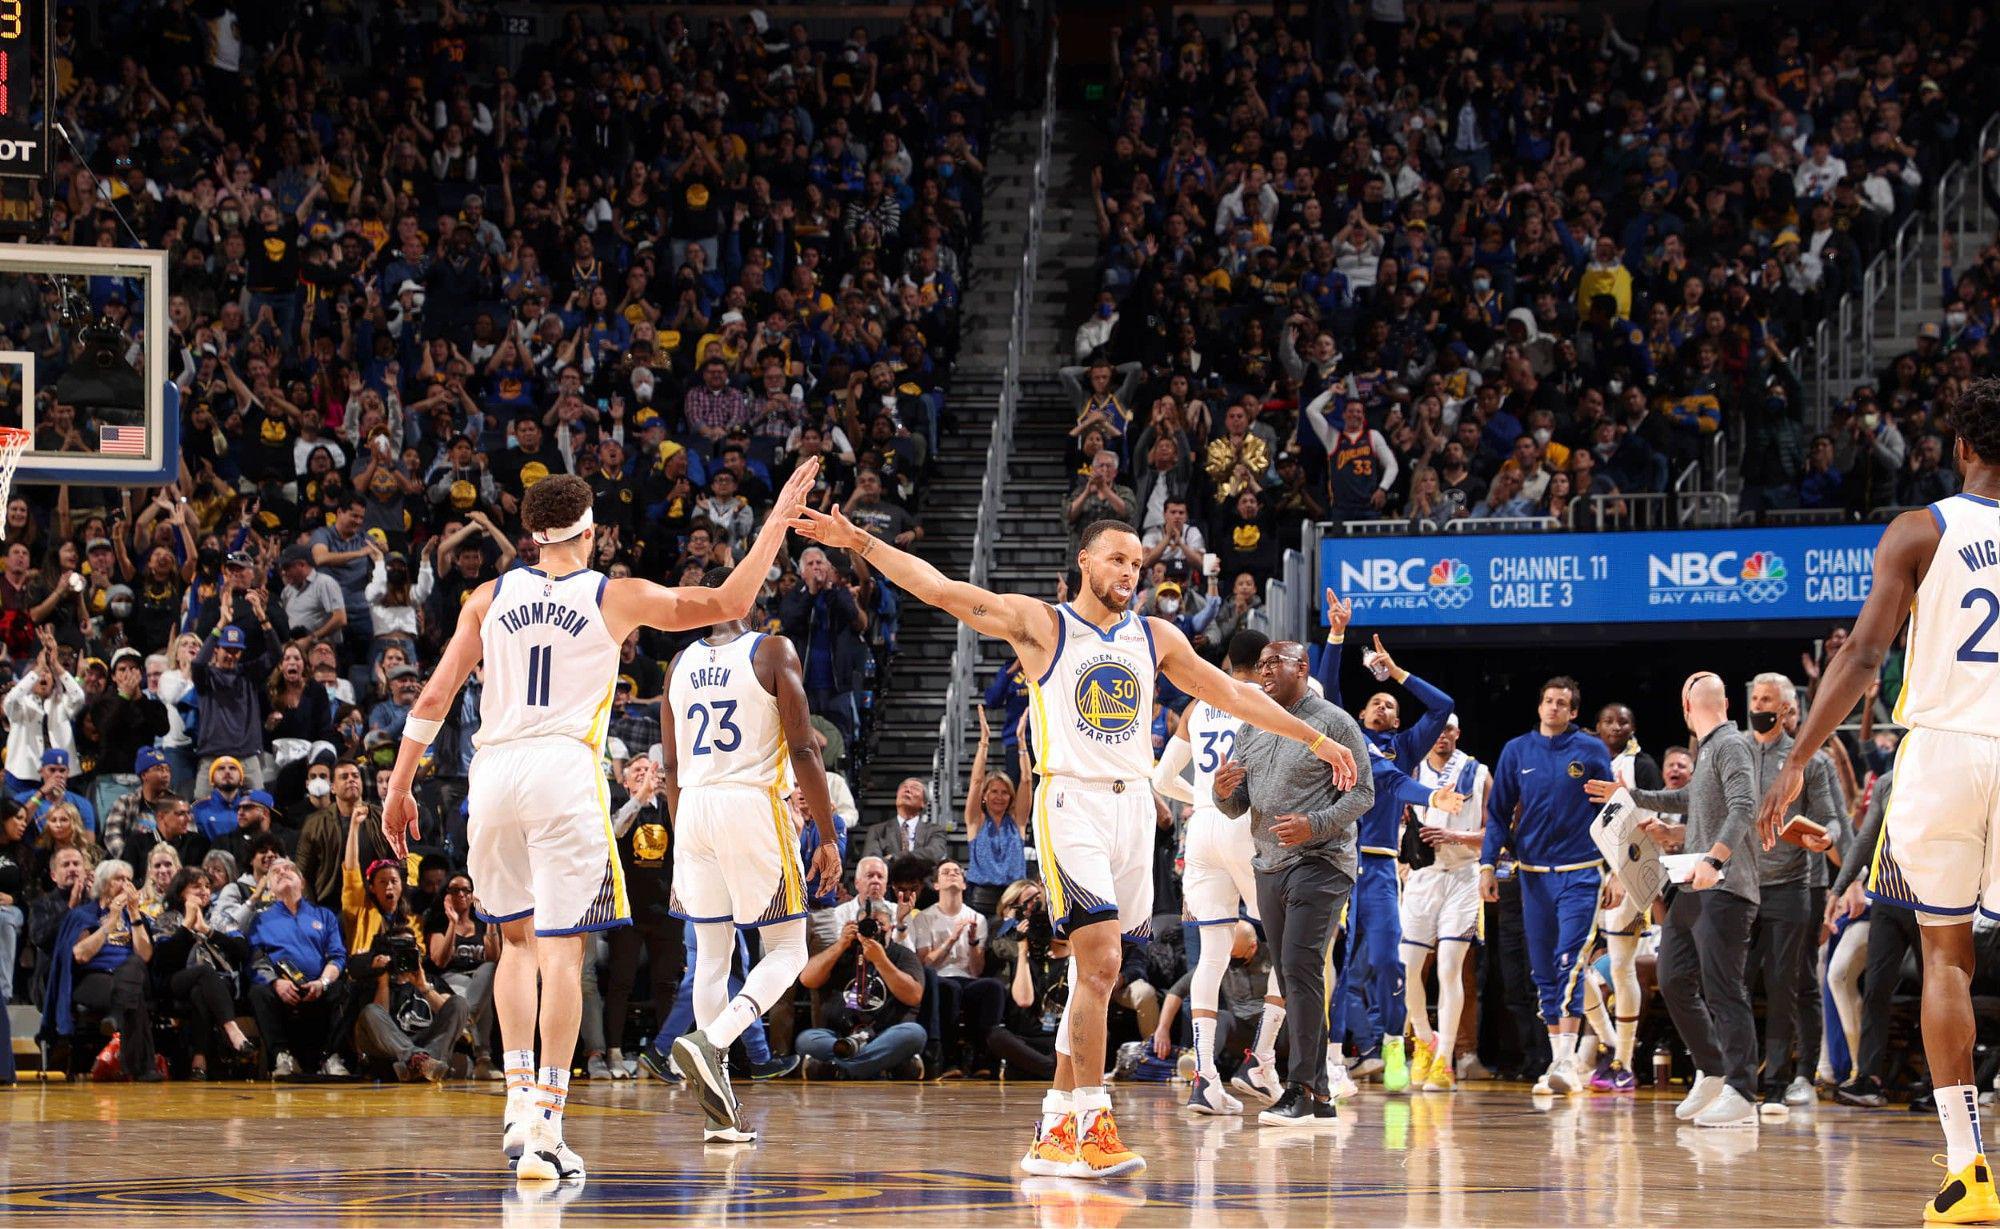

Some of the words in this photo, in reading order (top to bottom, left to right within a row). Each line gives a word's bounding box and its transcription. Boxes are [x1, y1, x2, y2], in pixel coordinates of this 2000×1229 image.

[509, 18, 529, 33] 22
[1353, 460, 1373, 475] 33
[1490, 556, 1586, 582] CHANNEL
[1590, 555, 1608, 580] 11
[1805, 548, 1877, 575] CHANN
[1958, 539, 2000, 572] WIG
[1341, 558, 1426, 592] NBC
[1649, 551, 1738, 587] NBC
[1490, 582, 1554, 608] CABLE
[1560, 582, 1573, 607] 3
[1649, 592, 1686, 604] BAY
[1690, 591, 1741, 603] AREA
[1805, 574, 1872, 602] CABLE
[1380, 596, 1429, 609] AREA
[498, 602, 589, 637] THOMPSON
[527, 645, 552, 706] 11
[1075, 653, 1113, 676] GOLDEN
[690, 667, 731, 689] GREEN
[1112, 679, 1135, 699] 30
[687, 699, 742, 755] 23
[1076, 718, 1140, 744] WARRIORS
